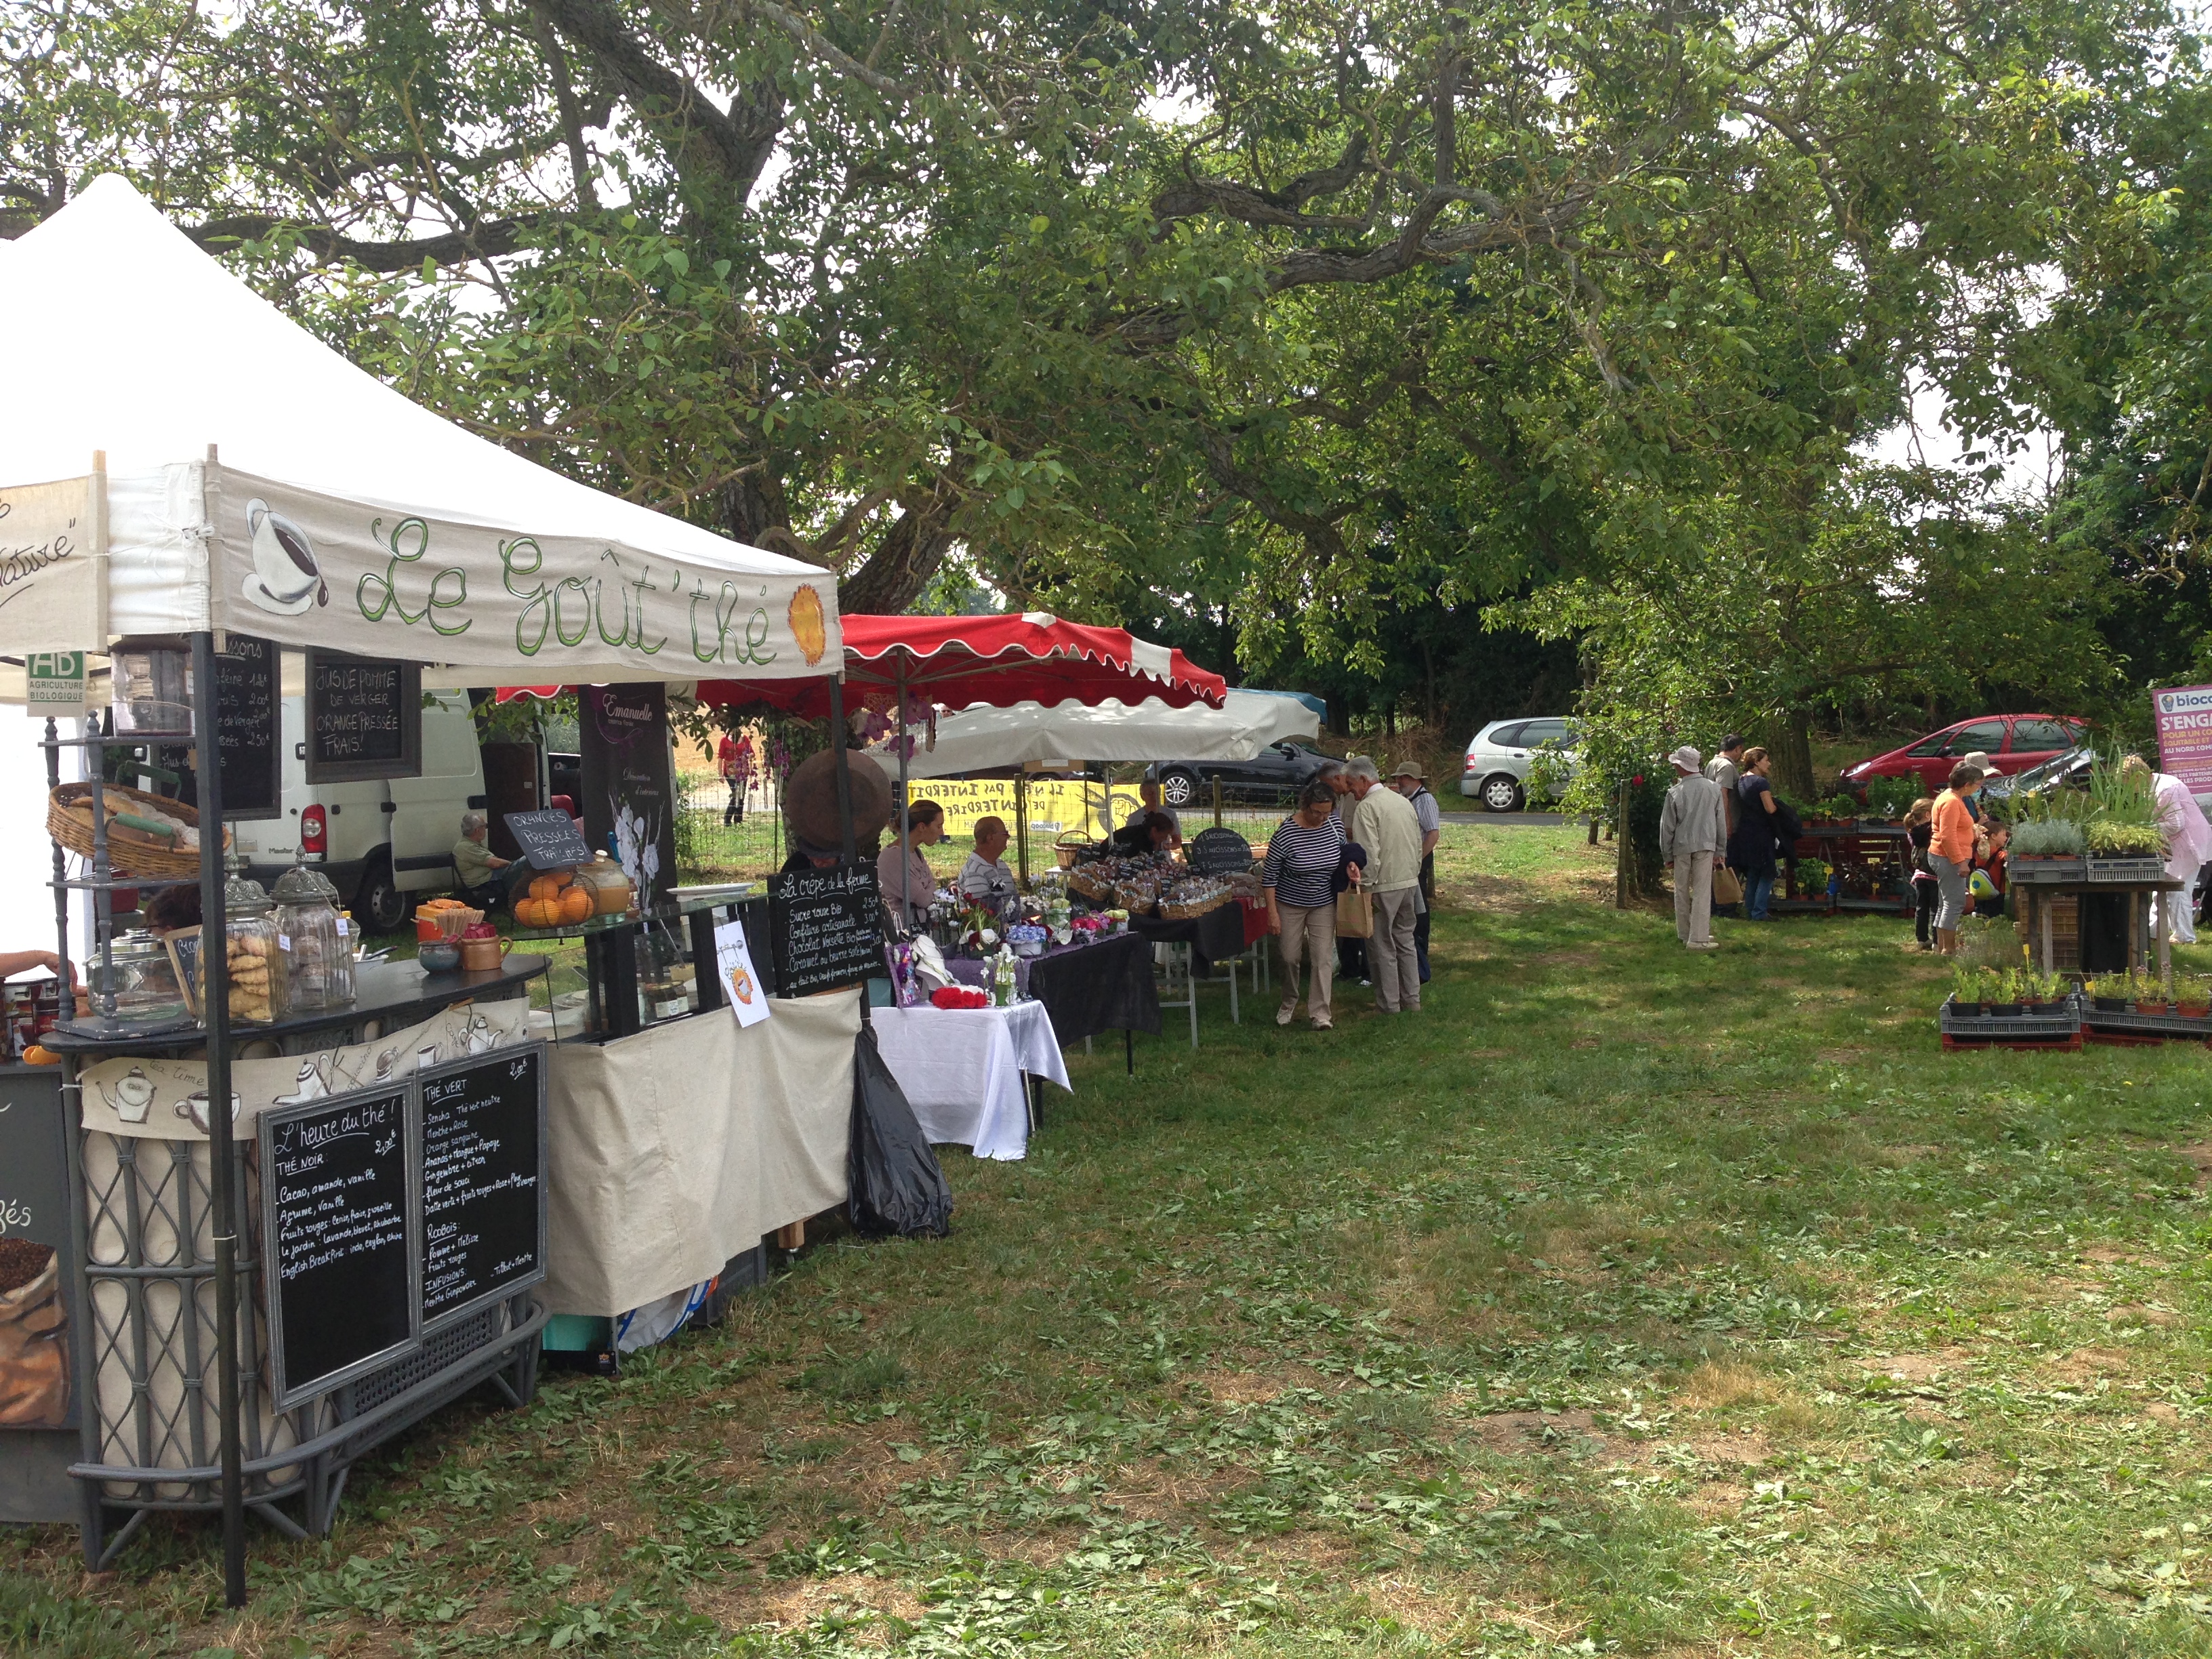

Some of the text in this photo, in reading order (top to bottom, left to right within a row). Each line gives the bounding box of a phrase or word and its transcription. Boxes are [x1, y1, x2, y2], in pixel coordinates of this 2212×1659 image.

[356, 517, 472, 636] Le
[29, 680, 83, 690] AGRICULTURE
[316, 665, 396, 695] JUS DE POMME
[30, 692, 83, 700] BIOLOGIQUE
[330, 693, 390, 707] DE VERGER
[316, 709, 398, 732] ORANGE PRESSÉE
[2163, 731, 2187, 740] POUR
[2188, 729, 2200, 738] UN
[2175, 745, 2195, 753] NORD
[779, 867, 873, 900] La crêpe de la ferme
[789, 909, 811, 924] Sucre
[830, 903, 842, 915] Bio
[789, 924, 821, 942] Confiture
[821, 914, 857, 933] artisanale
[788, 937, 821, 957] Chocolat
[822, 930, 845, 949] Noisette
[789, 954, 820, 973] Caramel
[820, 956, 828, 965] au
[829, 949, 848, 962] beurre
[148, 1059, 205, 1086] tea time
[423, 1080, 441, 1101] THÉ
[427, 1110, 451, 1125] Sencha
[274, 1120, 339, 1155] L'heure
[341, 1112, 360, 1132] du
[362, 1104, 386, 1129] thé
[426, 1130, 479, 1155] Orange sanguine
[275, 1155, 298, 1176] THÉ
[424, 1163, 460, 1184] Gingembre
[311, 1176, 346, 1195] amande,
[347, 1168, 376, 1185] vanille
[443, 1182, 453, 1193] de
[429, 1245, 451, 1261] Pomme
[447, 1252, 467, 1265] rouges
[281, 1259, 308, 1279] English
[424, 1279, 477, 1309] Menthe Gunpowder
